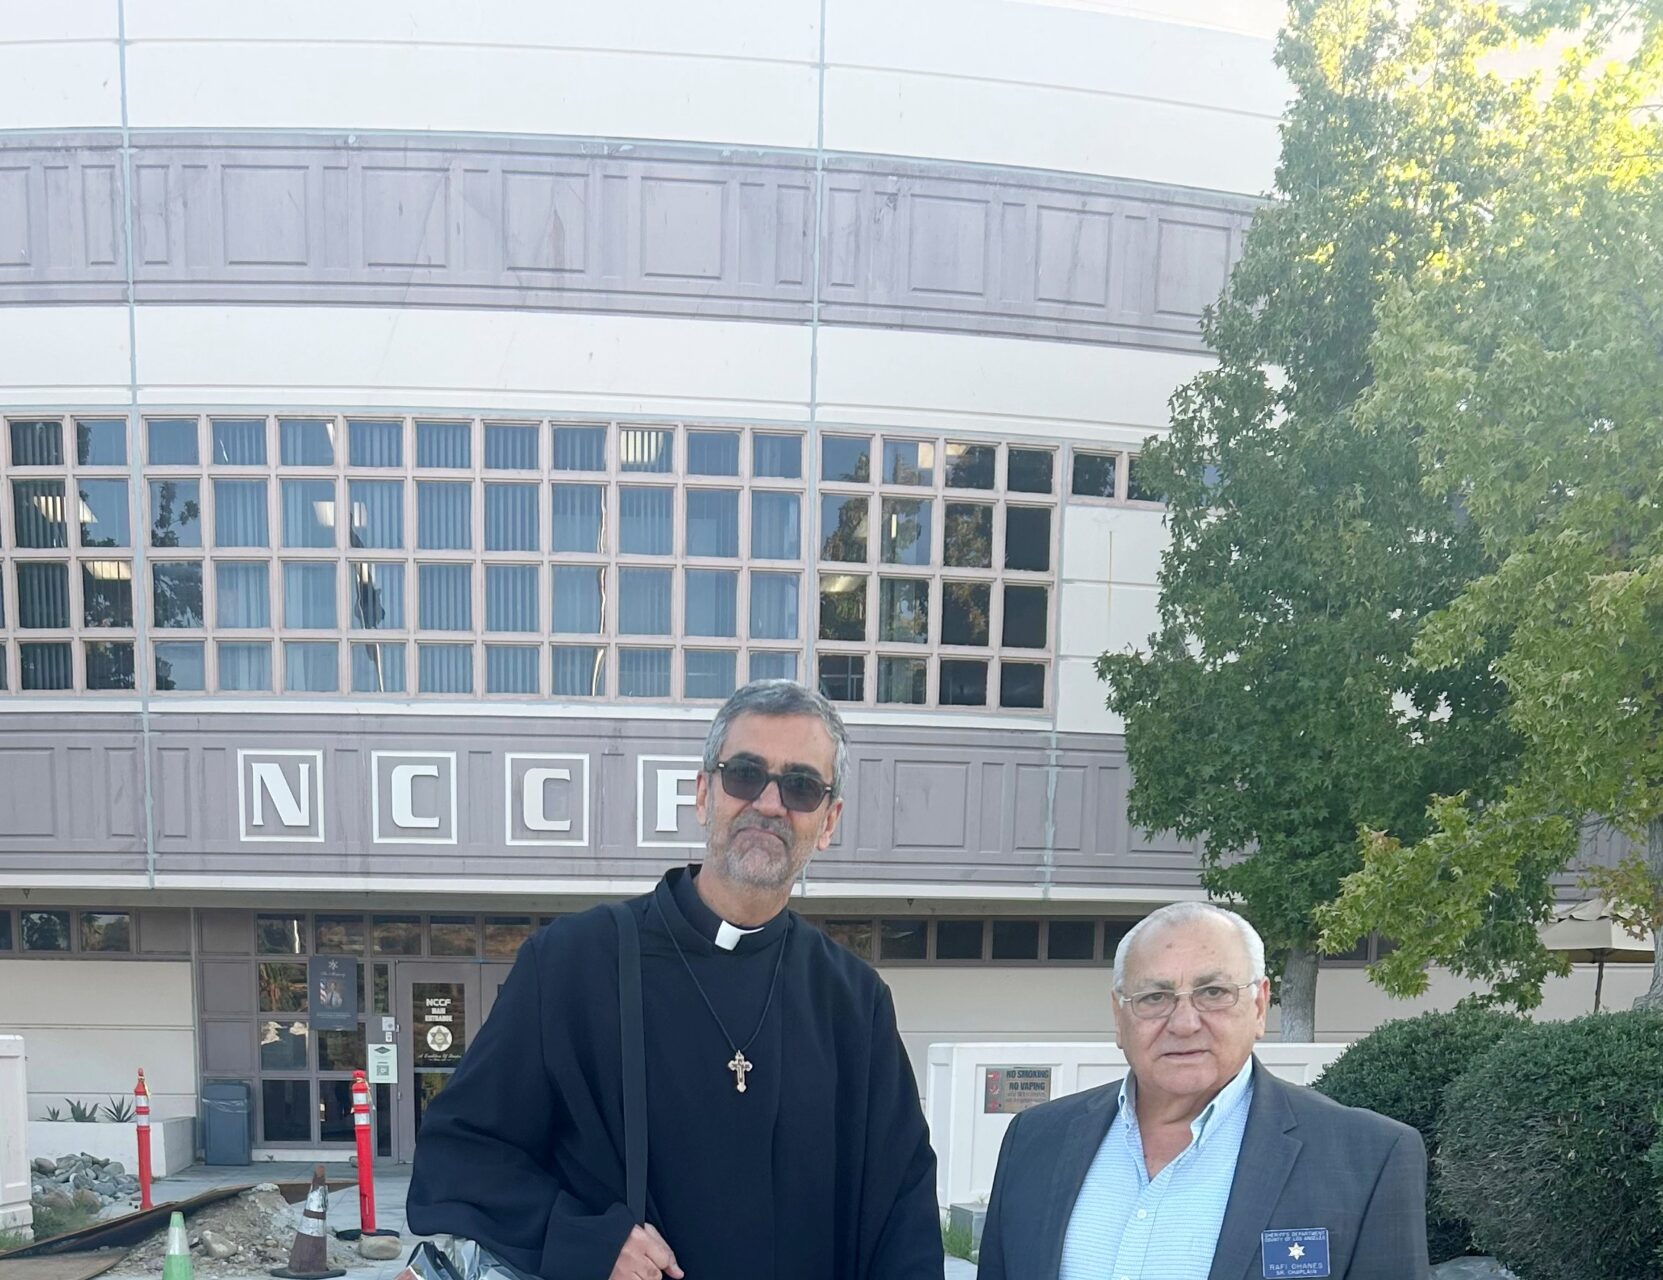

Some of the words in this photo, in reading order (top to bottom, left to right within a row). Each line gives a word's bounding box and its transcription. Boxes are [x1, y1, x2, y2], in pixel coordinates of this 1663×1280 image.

[250, 762, 697, 832] NCCF
[426, 998, 451, 1006] NCCF
[1006, 1070, 1016, 1078] NO
[1017, 1070, 1049, 1079] SMOKING
[1009, 1082, 1019, 1090] NO
[1020, 1082, 1046, 1091] VAPING
